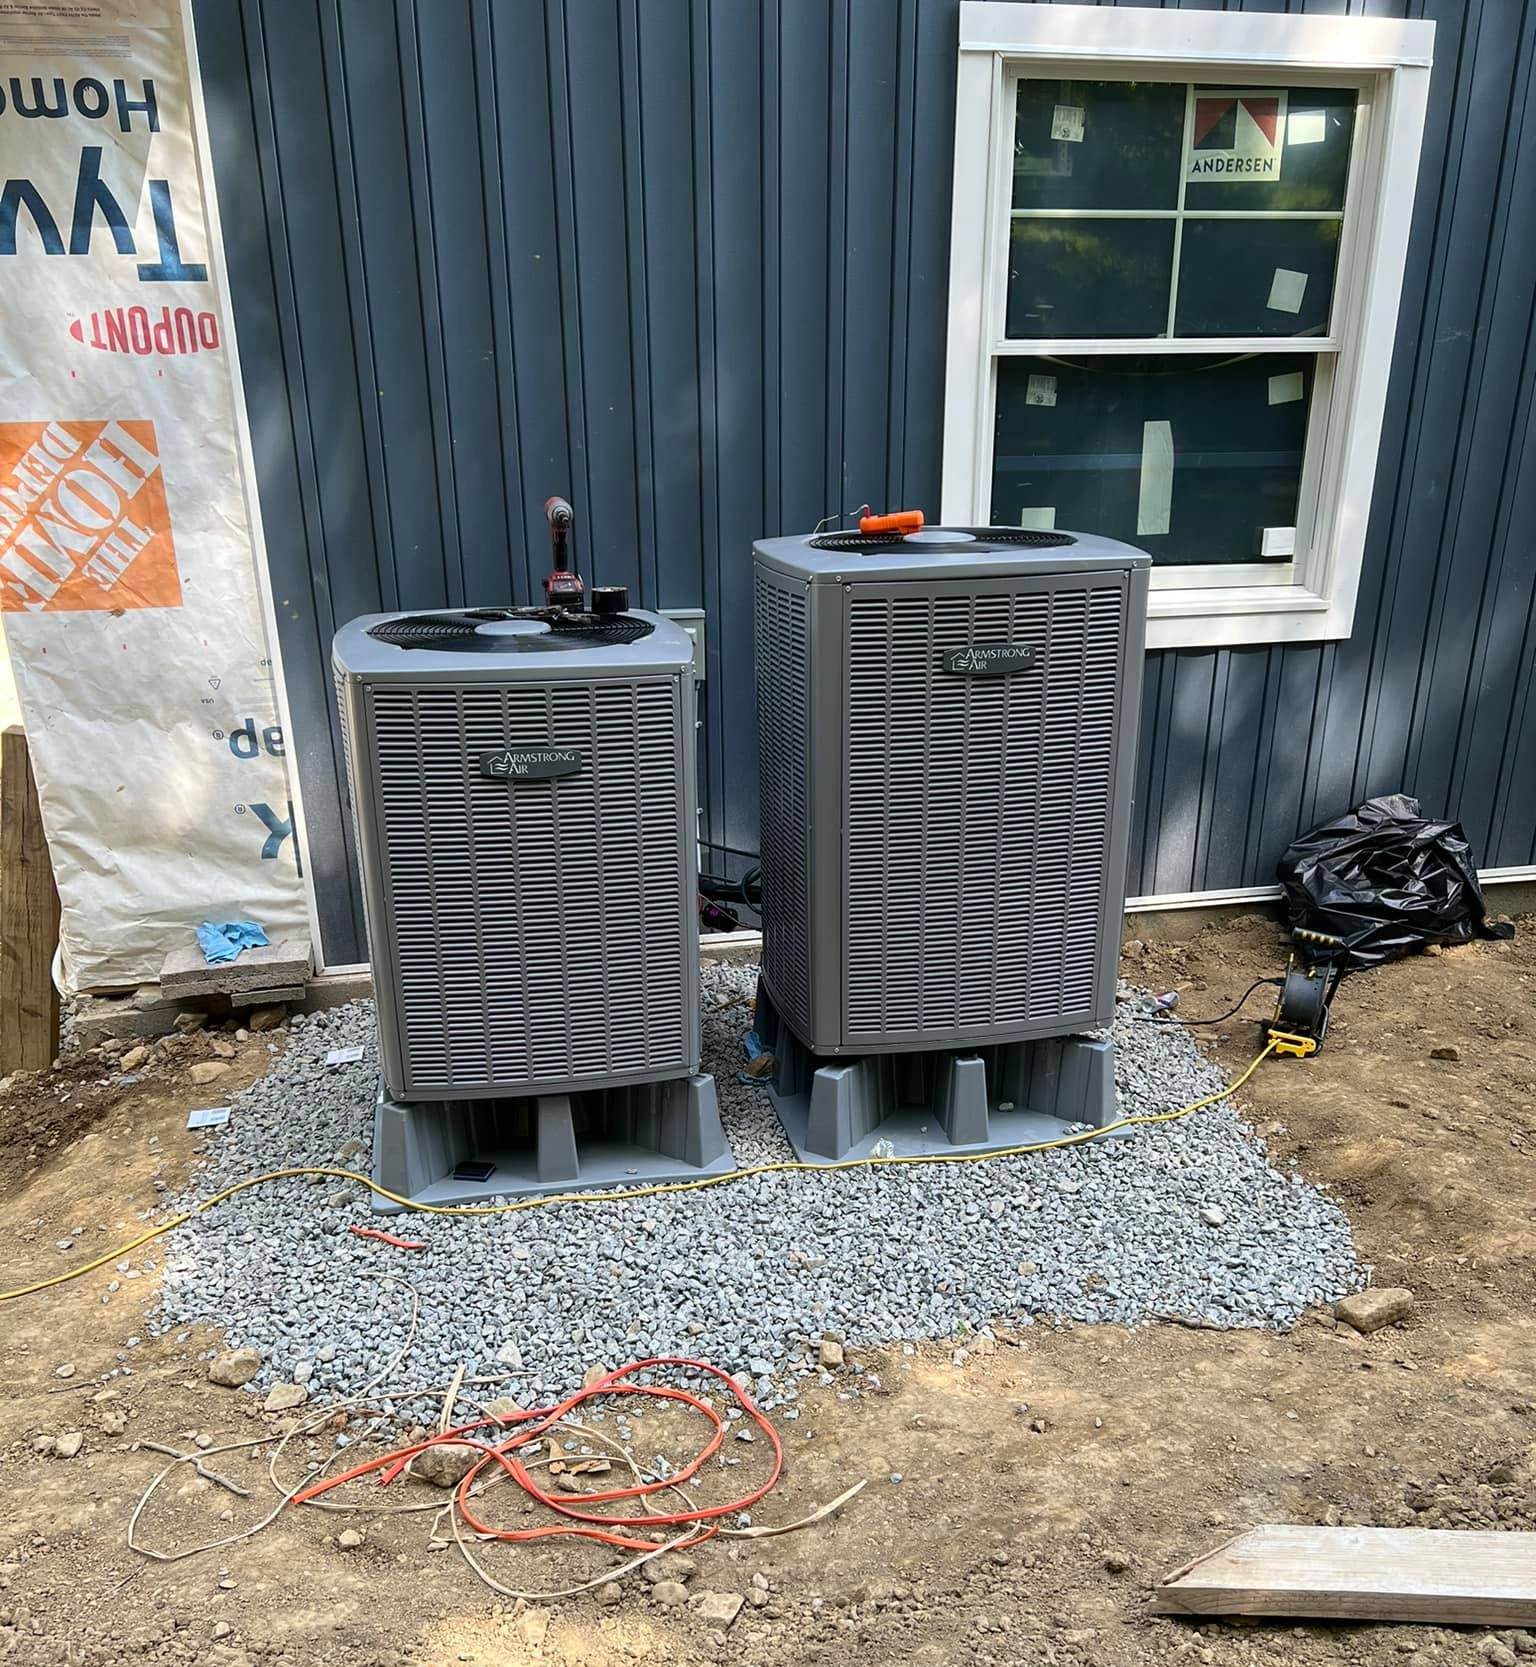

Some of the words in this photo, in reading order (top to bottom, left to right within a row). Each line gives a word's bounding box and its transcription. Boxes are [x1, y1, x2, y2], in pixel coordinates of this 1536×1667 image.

[0, 77, 160, 133] Hom
[1192, 158, 1273, 173] ANDERSEN
[90, 306, 220, 355] DUPONT
[81, 516, 158, 592] THE
[965, 648, 1031, 660] ARMSTRONG
[968, 659, 988, 671] AIR
[503, 751, 575, 763] ARMSTRONG
[508, 763, 529, 775] AIR
